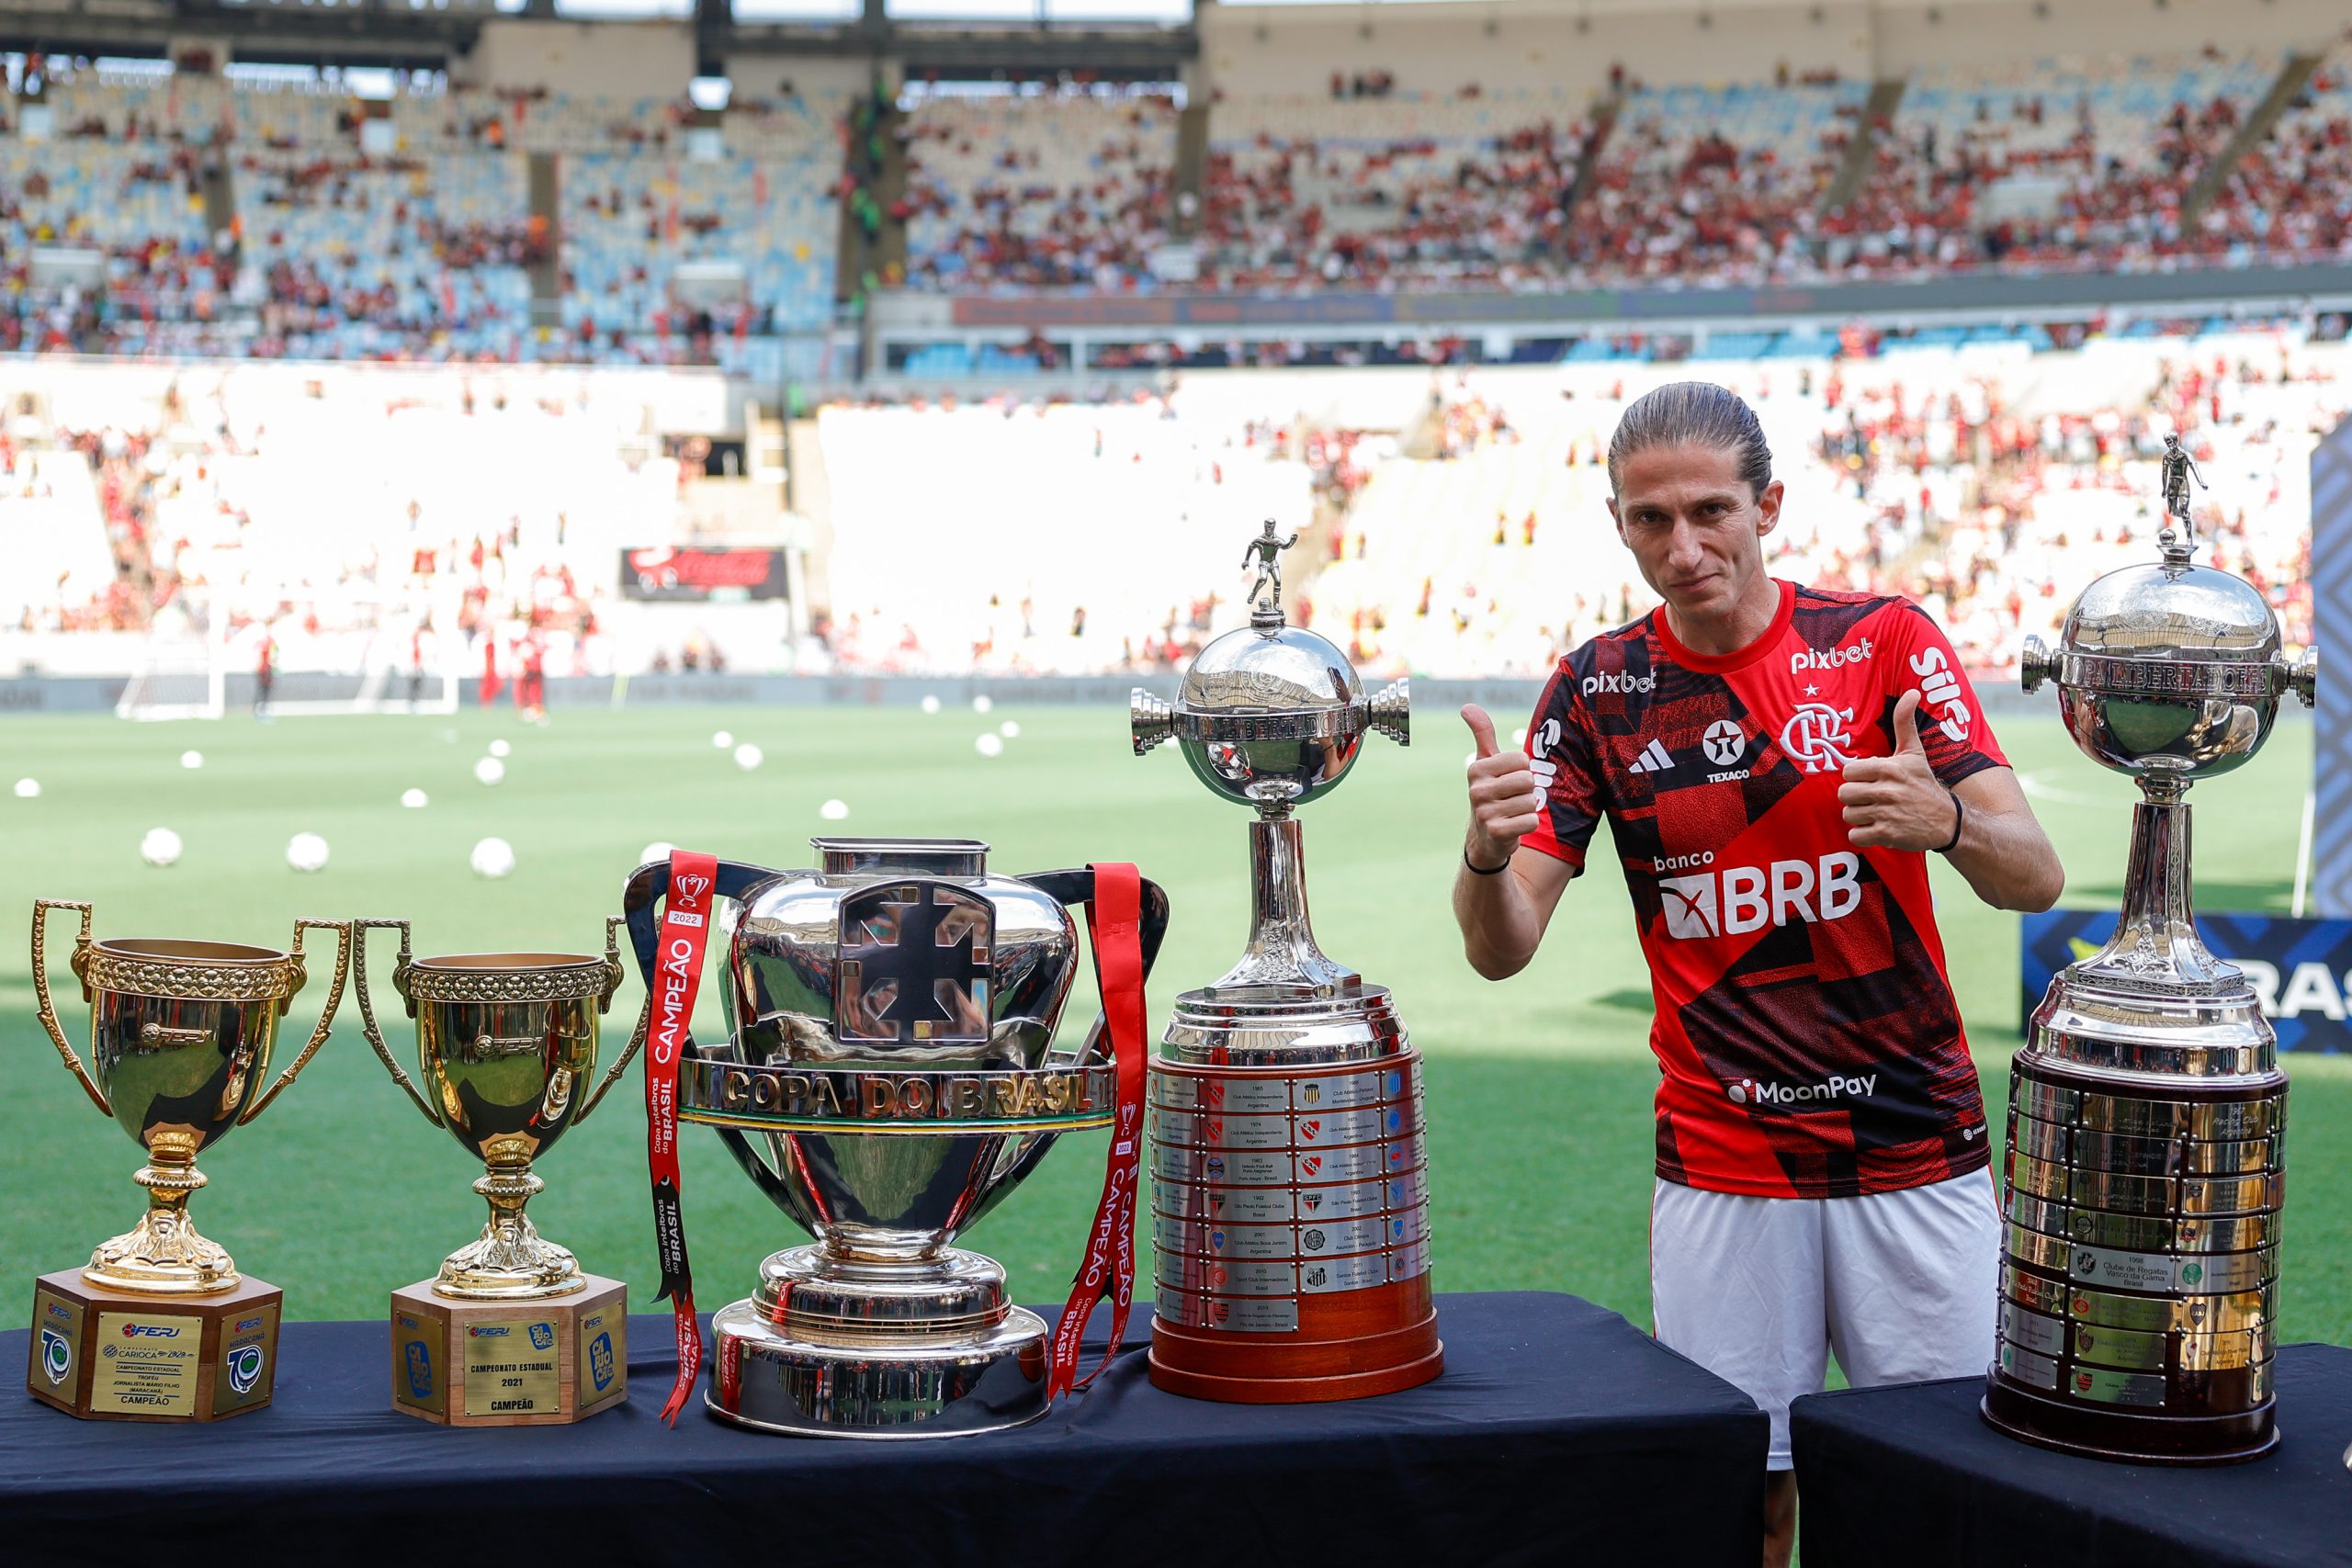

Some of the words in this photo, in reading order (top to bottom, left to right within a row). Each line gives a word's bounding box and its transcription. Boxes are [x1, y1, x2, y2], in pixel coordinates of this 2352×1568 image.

[1791, 637, 1873, 674] pixbet
[1582, 670, 1657, 697] pixbet
[2111, 660, 2267, 691] LIBERTADORES
[1707, 770, 1749, 784] TEXACO
[1654, 851, 1714, 872] banco
[1723, 851, 1861, 935] BRB
[673, 913, 698, 925] 2022
[2223, 958, 2352, 1021] RA
[655, 938, 693, 1065] CAMPEÃO
[723, 1070, 842, 1113] COPA
[865, 1077, 933, 1113] DO
[953, 1074, 1091, 1116] BRASIL
[1755, 1074, 1877, 1104] MoonPay
[651, 1077, 661, 1125] Intelbras
[661, 1079, 672, 1141] BRASIL
[2212, 1117, 2241, 1126] Racing
[2243, 1116, 2258, 1124] Club
[662, 1142, 668, 1154] do
[1118, 1144, 1129, 1154] 2022
[658, 1199, 668, 1246] Intelbras
[667, 1201, 681, 1261] BRASIL
[1085, 1168, 1125, 1286] CAMPEÃO
[1117, 1191, 1132, 1307] CAMPEÃO
[673, 1262, 679, 1274] do
[2103, 1262, 2124, 1271] Clube
[2137, 1267, 2168, 1275] Regatas
[2106, 1269, 2129, 1279] Vasco
[1079, 1298, 1091, 1319] Copa
[135, 1325, 180, 1337] FERJ
[478, 1327, 510, 1336] FERJ
[1057, 1311, 1078, 1368] BRASIL
[119, 1350, 157, 1359] CARIOCA
[1068, 1322, 1082, 1366] Intelbras
[470, 1364, 516, 1373] CAMPEONATO
[519, 1362, 553, 1371] ESTADUAL
[502, 1378, 523, 1387] 2021
[121, 1396, 170, 1405] CAMPEÃO
[491, 1398, 533, 1411] CAMPEÃO
